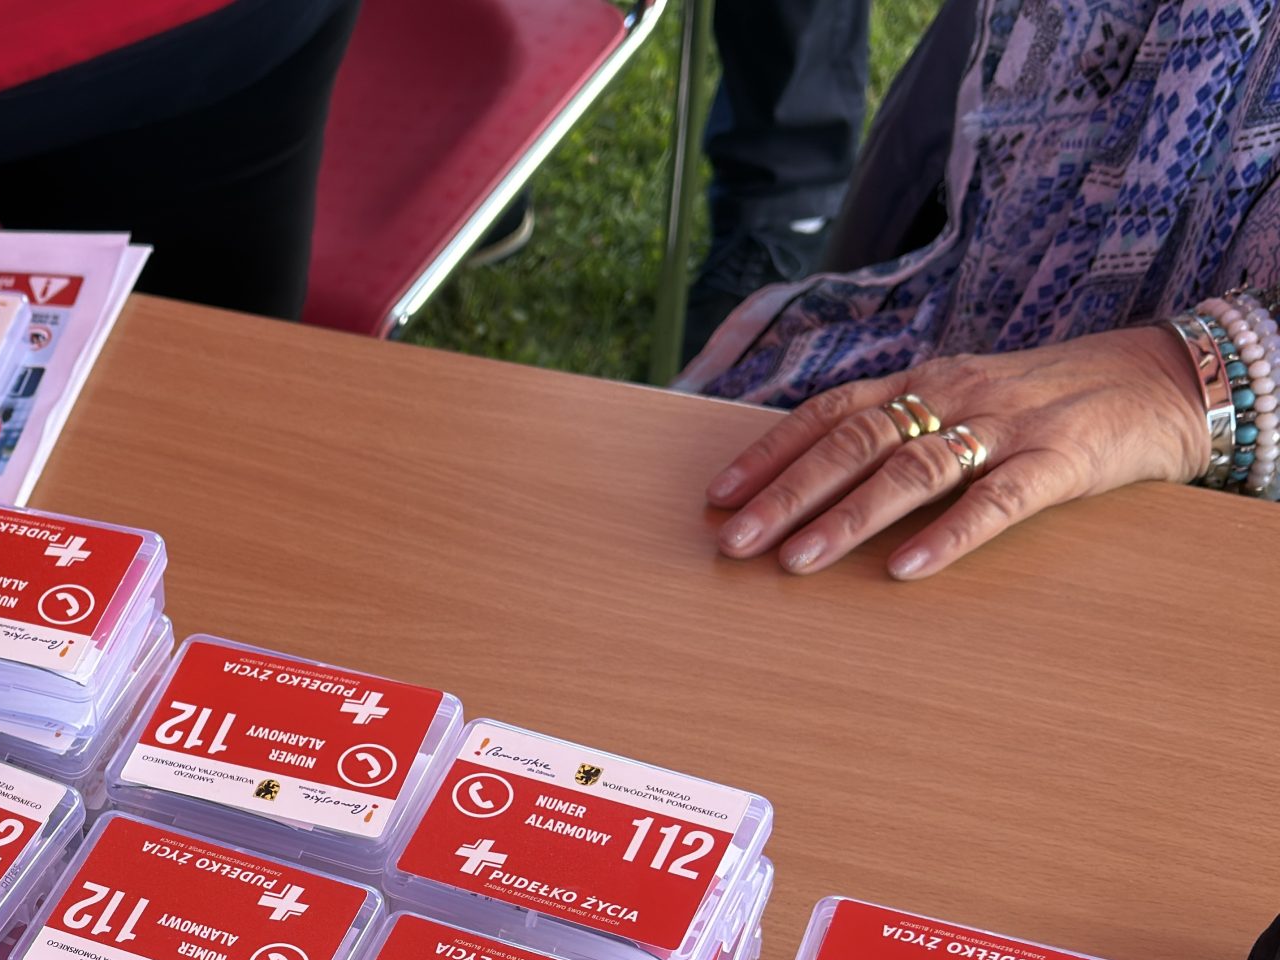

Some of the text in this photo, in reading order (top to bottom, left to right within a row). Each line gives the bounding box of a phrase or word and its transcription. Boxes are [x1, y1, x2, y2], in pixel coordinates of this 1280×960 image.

[222, 661, 356, 696] PUDEŁKO ŻYCIA
[154, 700, 235, 753] 112
[245, 724, 325, 749] ALARMOWY
[268, 748, 316, 768] NUMER
[485, 746, 551, 770] Pomorskie
[302, 792, 366, 813] Pomorskie
[535, 795, 586, 818] NUMER
[602, 781, 728, 820] WOJEWÓDZTWA POMORSKIEGO
[645, 785, 691, 801] SAMORZĄD
[524, 814, 612, 846] ALARMOWY
[141, 840, 277, 888] PUDEŁKO ŻYCIA
[623, 817, 715, 880] 112
[62, 880, 149, 942] 112
[488, 870, 638, 922] PUDEŁKO ŻYCIA
[156, 913, 238, 945] ALARMOWY
[882, 924, 941, 949] ŻYCIA
[46, 938, 101, 960] POMORSKIEGO
